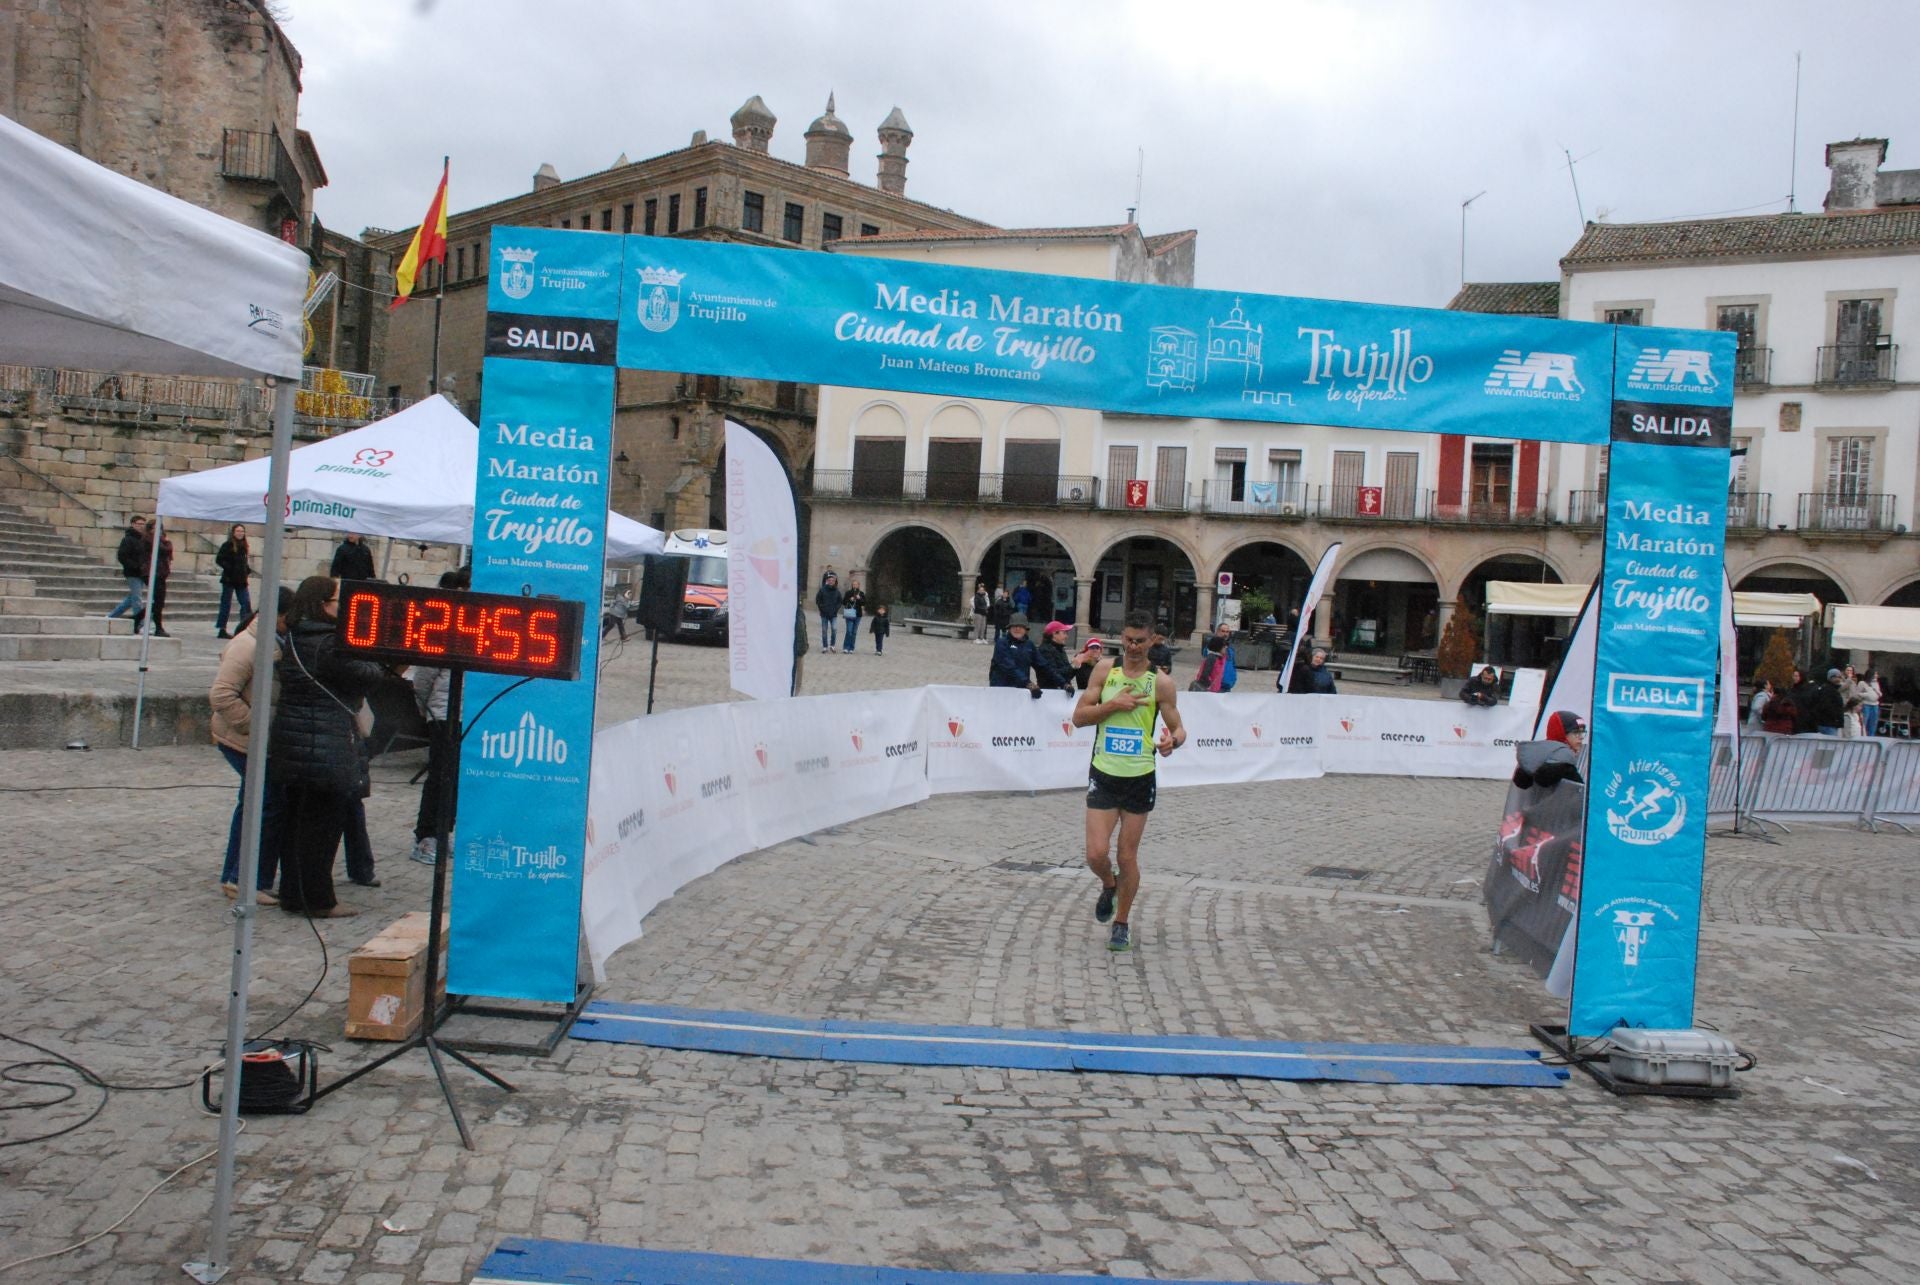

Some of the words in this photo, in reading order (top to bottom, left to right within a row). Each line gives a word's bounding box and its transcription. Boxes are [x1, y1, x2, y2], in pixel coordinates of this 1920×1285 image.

[541, 266, 597, 278] Ayuntamiento
[598, 270, 610, 278] de
[541, 276, 586, 291] Trujillo
[689, 291, 762, 306] Ayuntamiento
[764, 298, 777, 308] de
[873, 282, 978, 320] Media
[988, 293, 1124, 333] Maratón
[688, 304, 747, 323] Trujillo
[506, 326, 596, 353] SALIDA
[834, 312, 943, 350] Ciudad
[945, 325, 986, 352] de
[992, 327, 1096, 370] Trujillo
[879, 354, 914, 369] Juan
[917, 357, 970, 375] Mateos
[974, 363, 1041, 382] Broncano
[1297, 326, 1434, 395] Trujillo
[1327, 381, 1342, 402] te
[1484, 387, 1581, 402] www.musicrun.es
[1627, 380, 1714, 394] www.musicrun.es
[1631, 413, 1712, 437] SALIDA
[496, 422, 595, 451] Media
[314, 462, 392, 479] primaflor
[487, 457, 600, 485] Maratón
[291, 499, 357, 519] primaflor
[500, 488, 560, 509] Ciudad
[561, 494, 583, 510] de
[1624, 500, 1711, 525] Media
[485, 508, 593, 554] Trujillo
[1616, 531, 1716, 556] Maratón
[487, 555, 508, 566] Juan
[510, 556, 543, 568] Mateos
[545, 559, 589, 571] Broncano
[1626, 560, 1677, 578] Ciudad
[1679, 565, 1699, 580] de
[1612, 578, 1710, 619] Trujillo
[1613, 621, 1633, 630] Juan
[1635, 623, 1665, 632] Mateos
[1667, 625, 1706, 635] Broncano
[1620, 686, 1689, 705] HABLA
[481, 711, 568, 768] trujillo
[1111, 738, 1135, 752] 582
[1604, 770, 1622, 798] Club
[1628, 758, 1681, 787] Atletismo
[512, 844, 567, 870] Trujillo
[1594, 903, 1610, 917] Club
